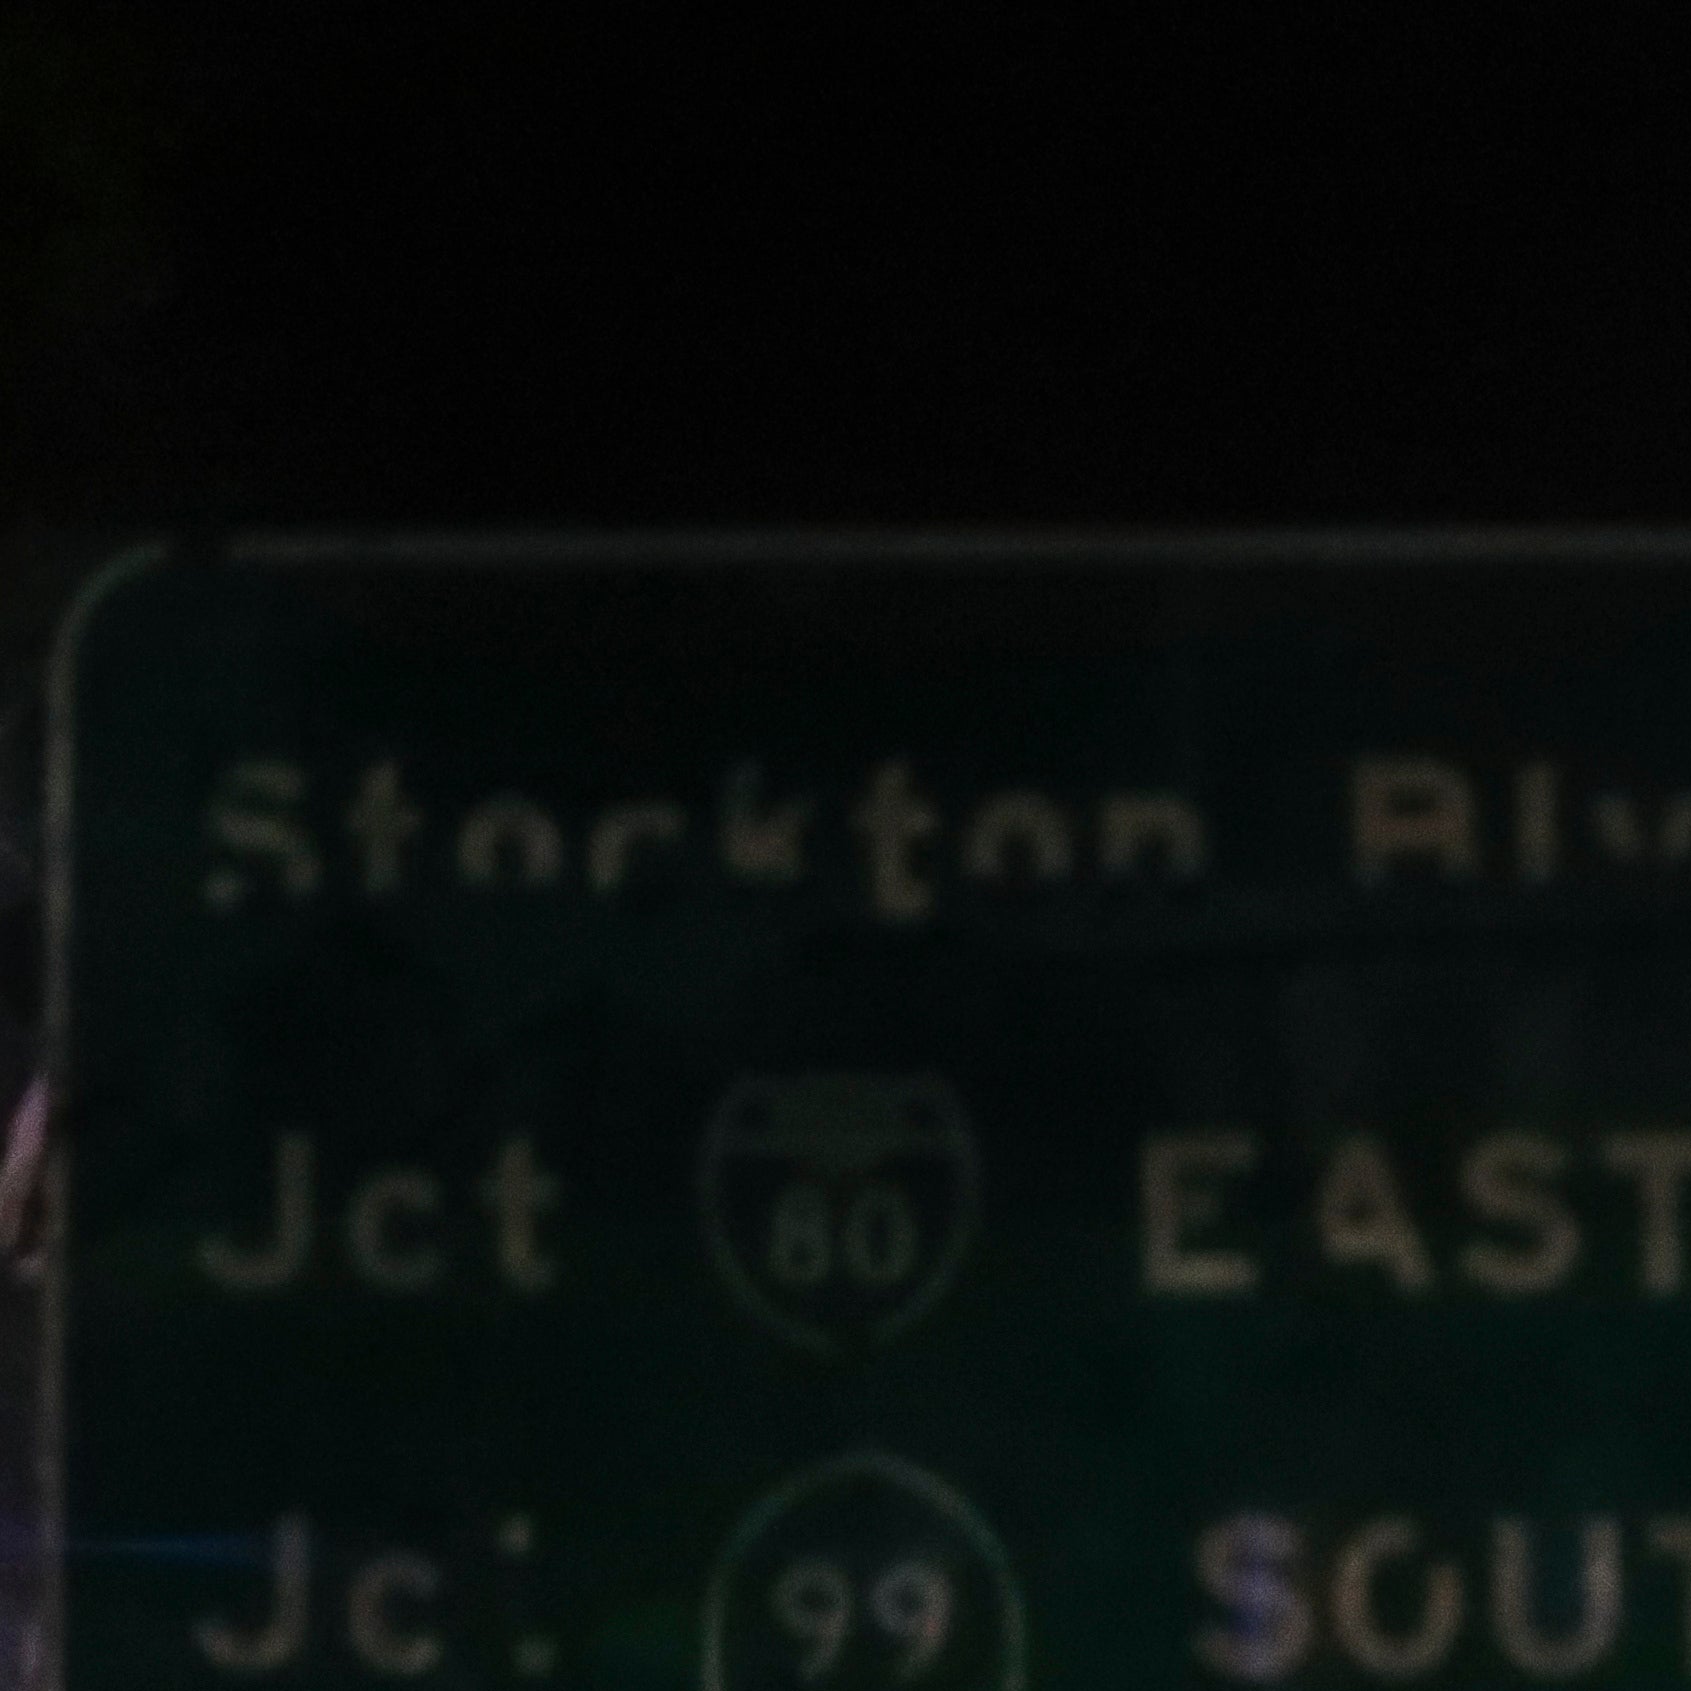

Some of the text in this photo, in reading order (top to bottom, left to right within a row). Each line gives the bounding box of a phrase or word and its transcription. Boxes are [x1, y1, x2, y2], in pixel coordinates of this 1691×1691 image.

[200, 1130, 561, 1293] Jct
[770, 1196, 918, 1288] 80
[772, 1558, 953, 1684] 99
